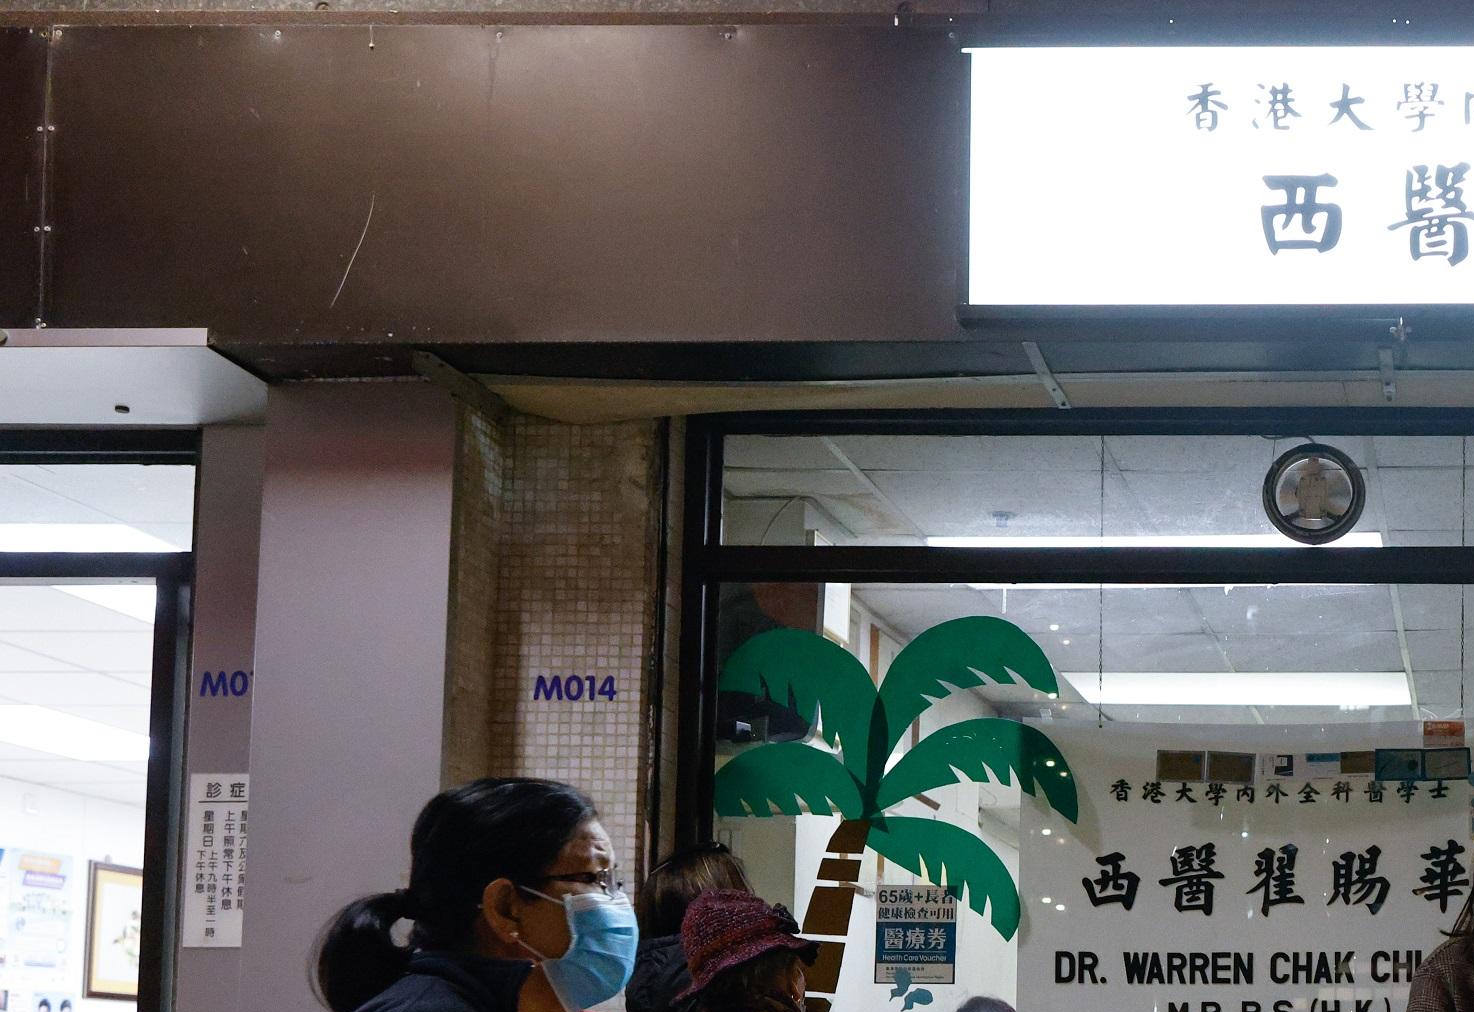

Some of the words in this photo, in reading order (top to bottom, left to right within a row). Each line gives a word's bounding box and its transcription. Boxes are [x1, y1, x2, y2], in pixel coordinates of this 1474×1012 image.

[200, 671, 253, 698] M0
[533, 675, 617, 702] M014
[206, 782, 246, 799] 診症
[1082, 839, 1469, 916] 西醫翟賜華
[919, 954, 947, 962] Voucher
[1055, 951, 1107, 984] DR.
[1123, 951, 1254, 984] WARREN
[1270, 951, 1355, 984] CHAK
